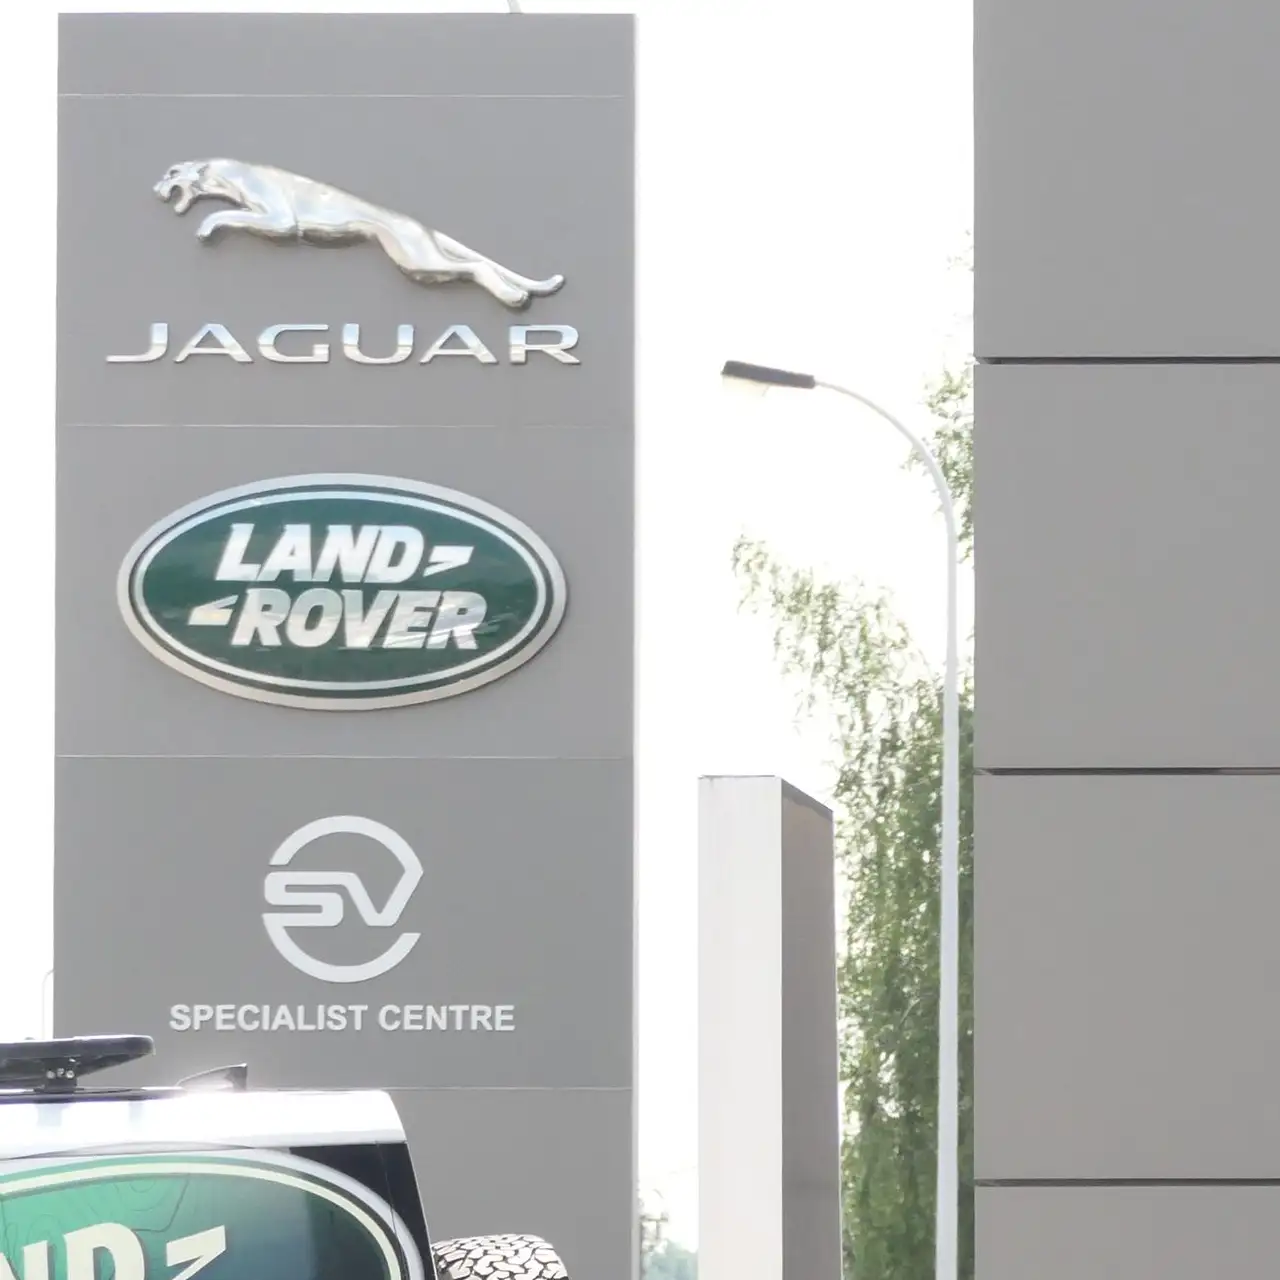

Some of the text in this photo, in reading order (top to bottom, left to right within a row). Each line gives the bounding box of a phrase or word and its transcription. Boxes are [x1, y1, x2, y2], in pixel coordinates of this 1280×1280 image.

[105, 322, 581, 365] JAGUAR
[215, 522, 425, 583] LAND
[230, 587, 488, 650] ROVER
[169, 1004, 515, 1031] SPECIALIST CENTRE
